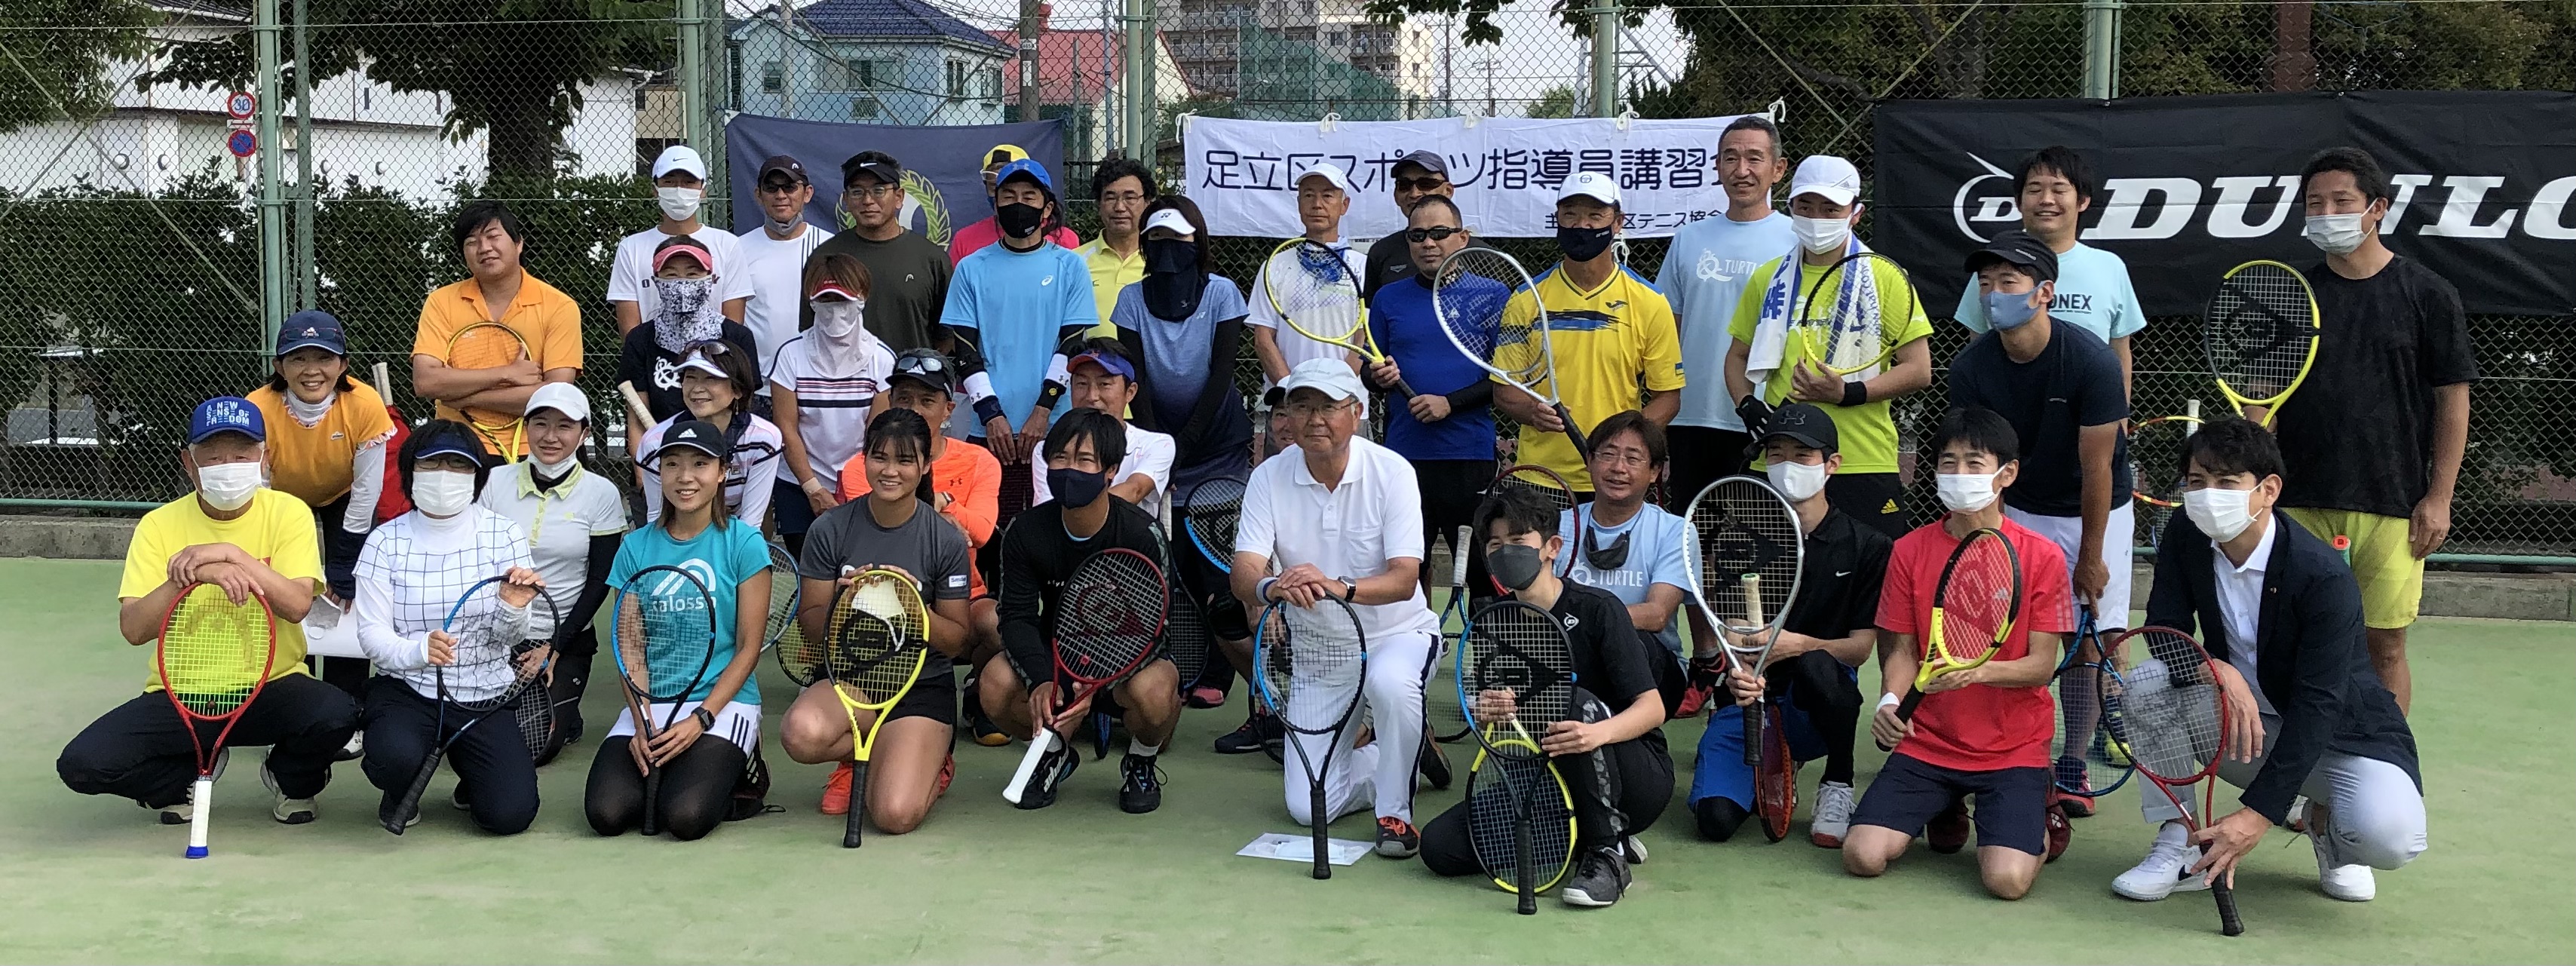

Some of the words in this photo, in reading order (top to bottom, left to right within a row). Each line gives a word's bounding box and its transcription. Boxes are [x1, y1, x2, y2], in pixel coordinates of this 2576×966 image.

[235, 99, 250, 111] 30
[1203, 148, 1722, 193] 足立区スポツ指導員講習
[1725, 259, 1763, 276] TURTL
[2047, 294, 2092, 311] ONEX
[1599, 570, 1642, 587] TURTLE
